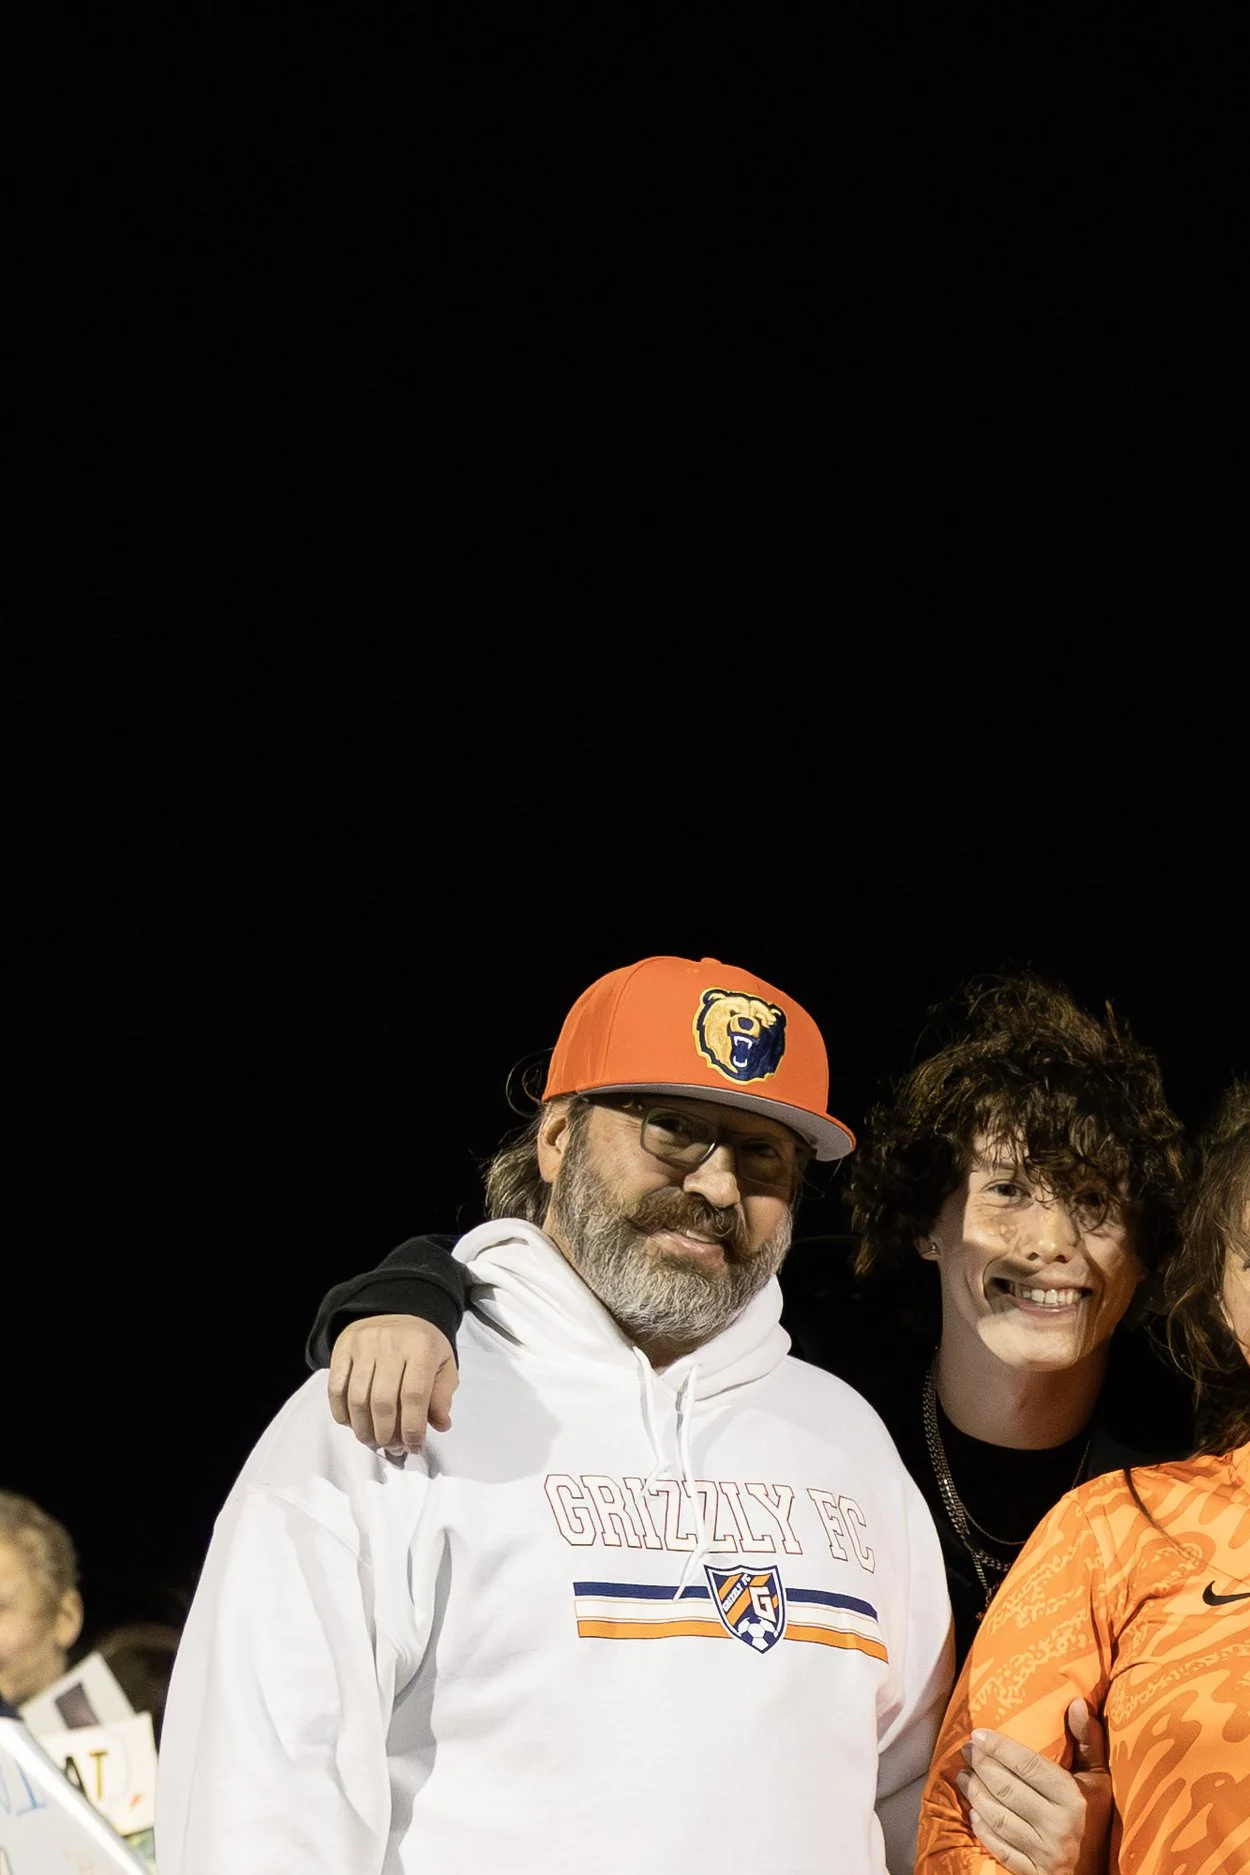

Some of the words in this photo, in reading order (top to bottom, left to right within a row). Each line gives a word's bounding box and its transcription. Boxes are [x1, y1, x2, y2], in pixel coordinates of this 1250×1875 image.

[543, 1473, 804, 1555] GRIZZLY
[805, 1487, 877, 1574] FC
[749, 1585, 777, 1624] G
